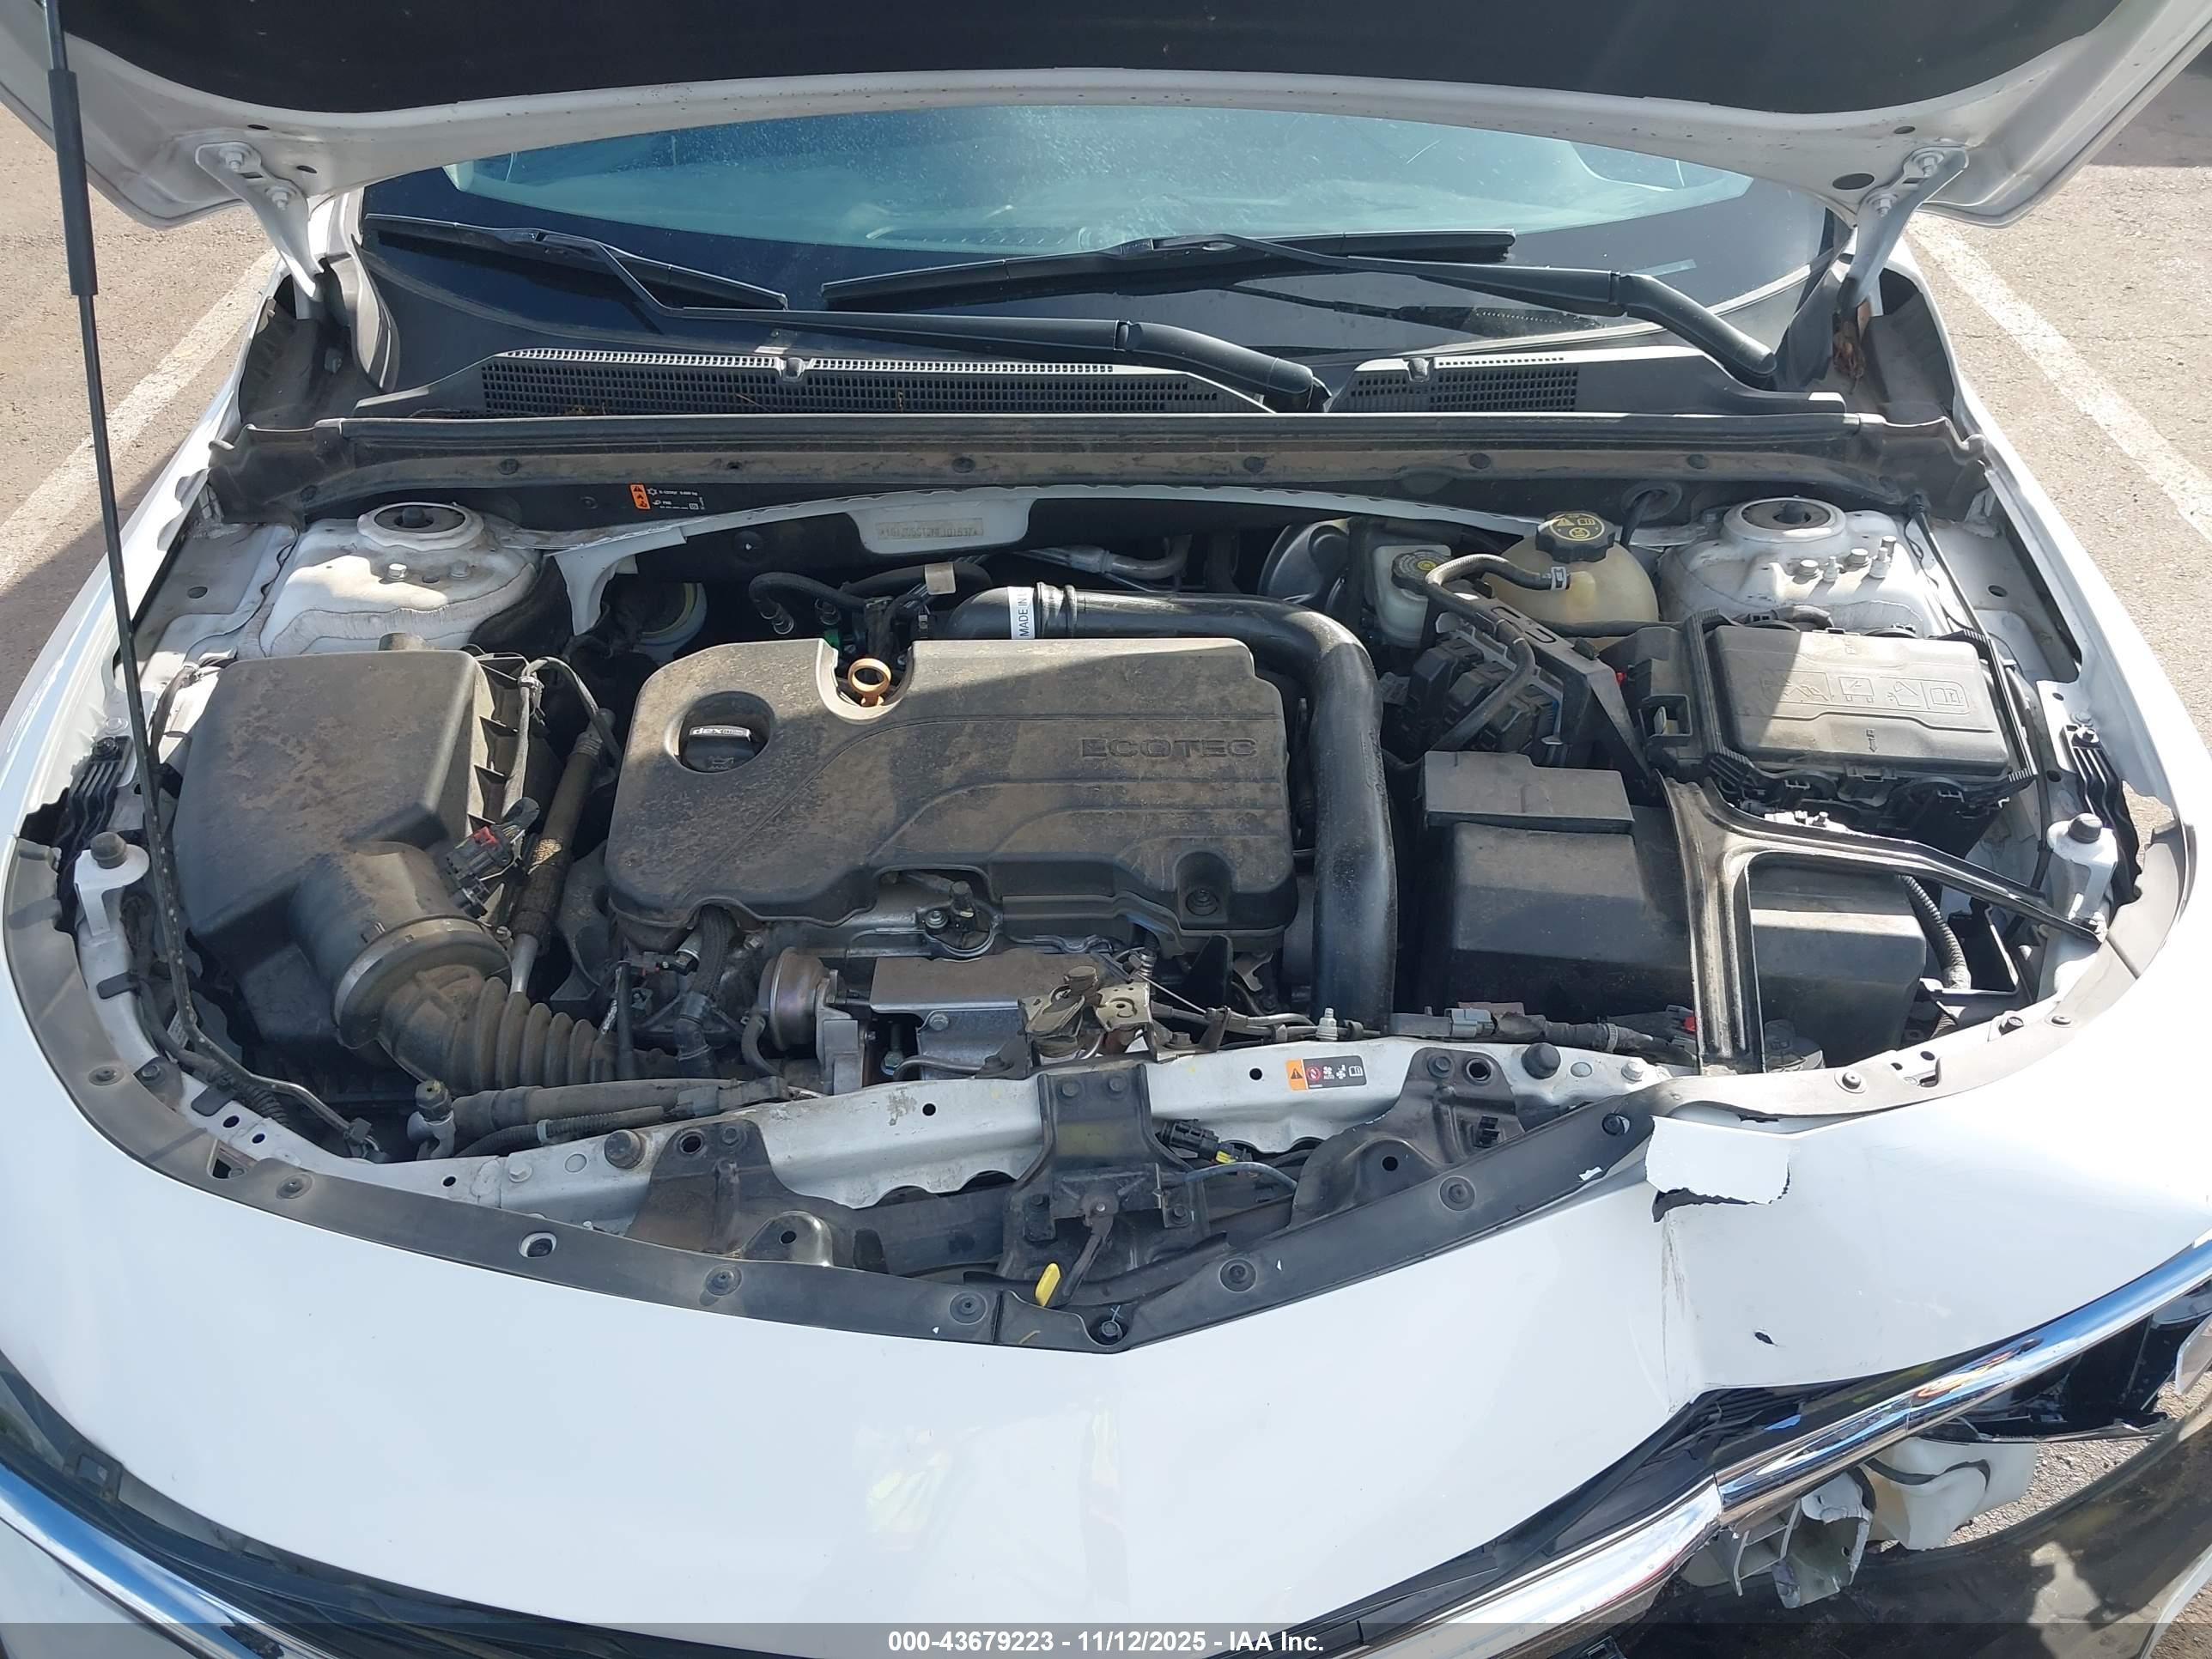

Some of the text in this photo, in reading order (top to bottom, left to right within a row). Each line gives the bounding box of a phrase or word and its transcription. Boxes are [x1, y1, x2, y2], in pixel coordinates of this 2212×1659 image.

[1017, 598, 1027, 606] IN
[1018, 609, 1030, 636] MADE
[1081, 738, 1258, 758] ECOTEC
